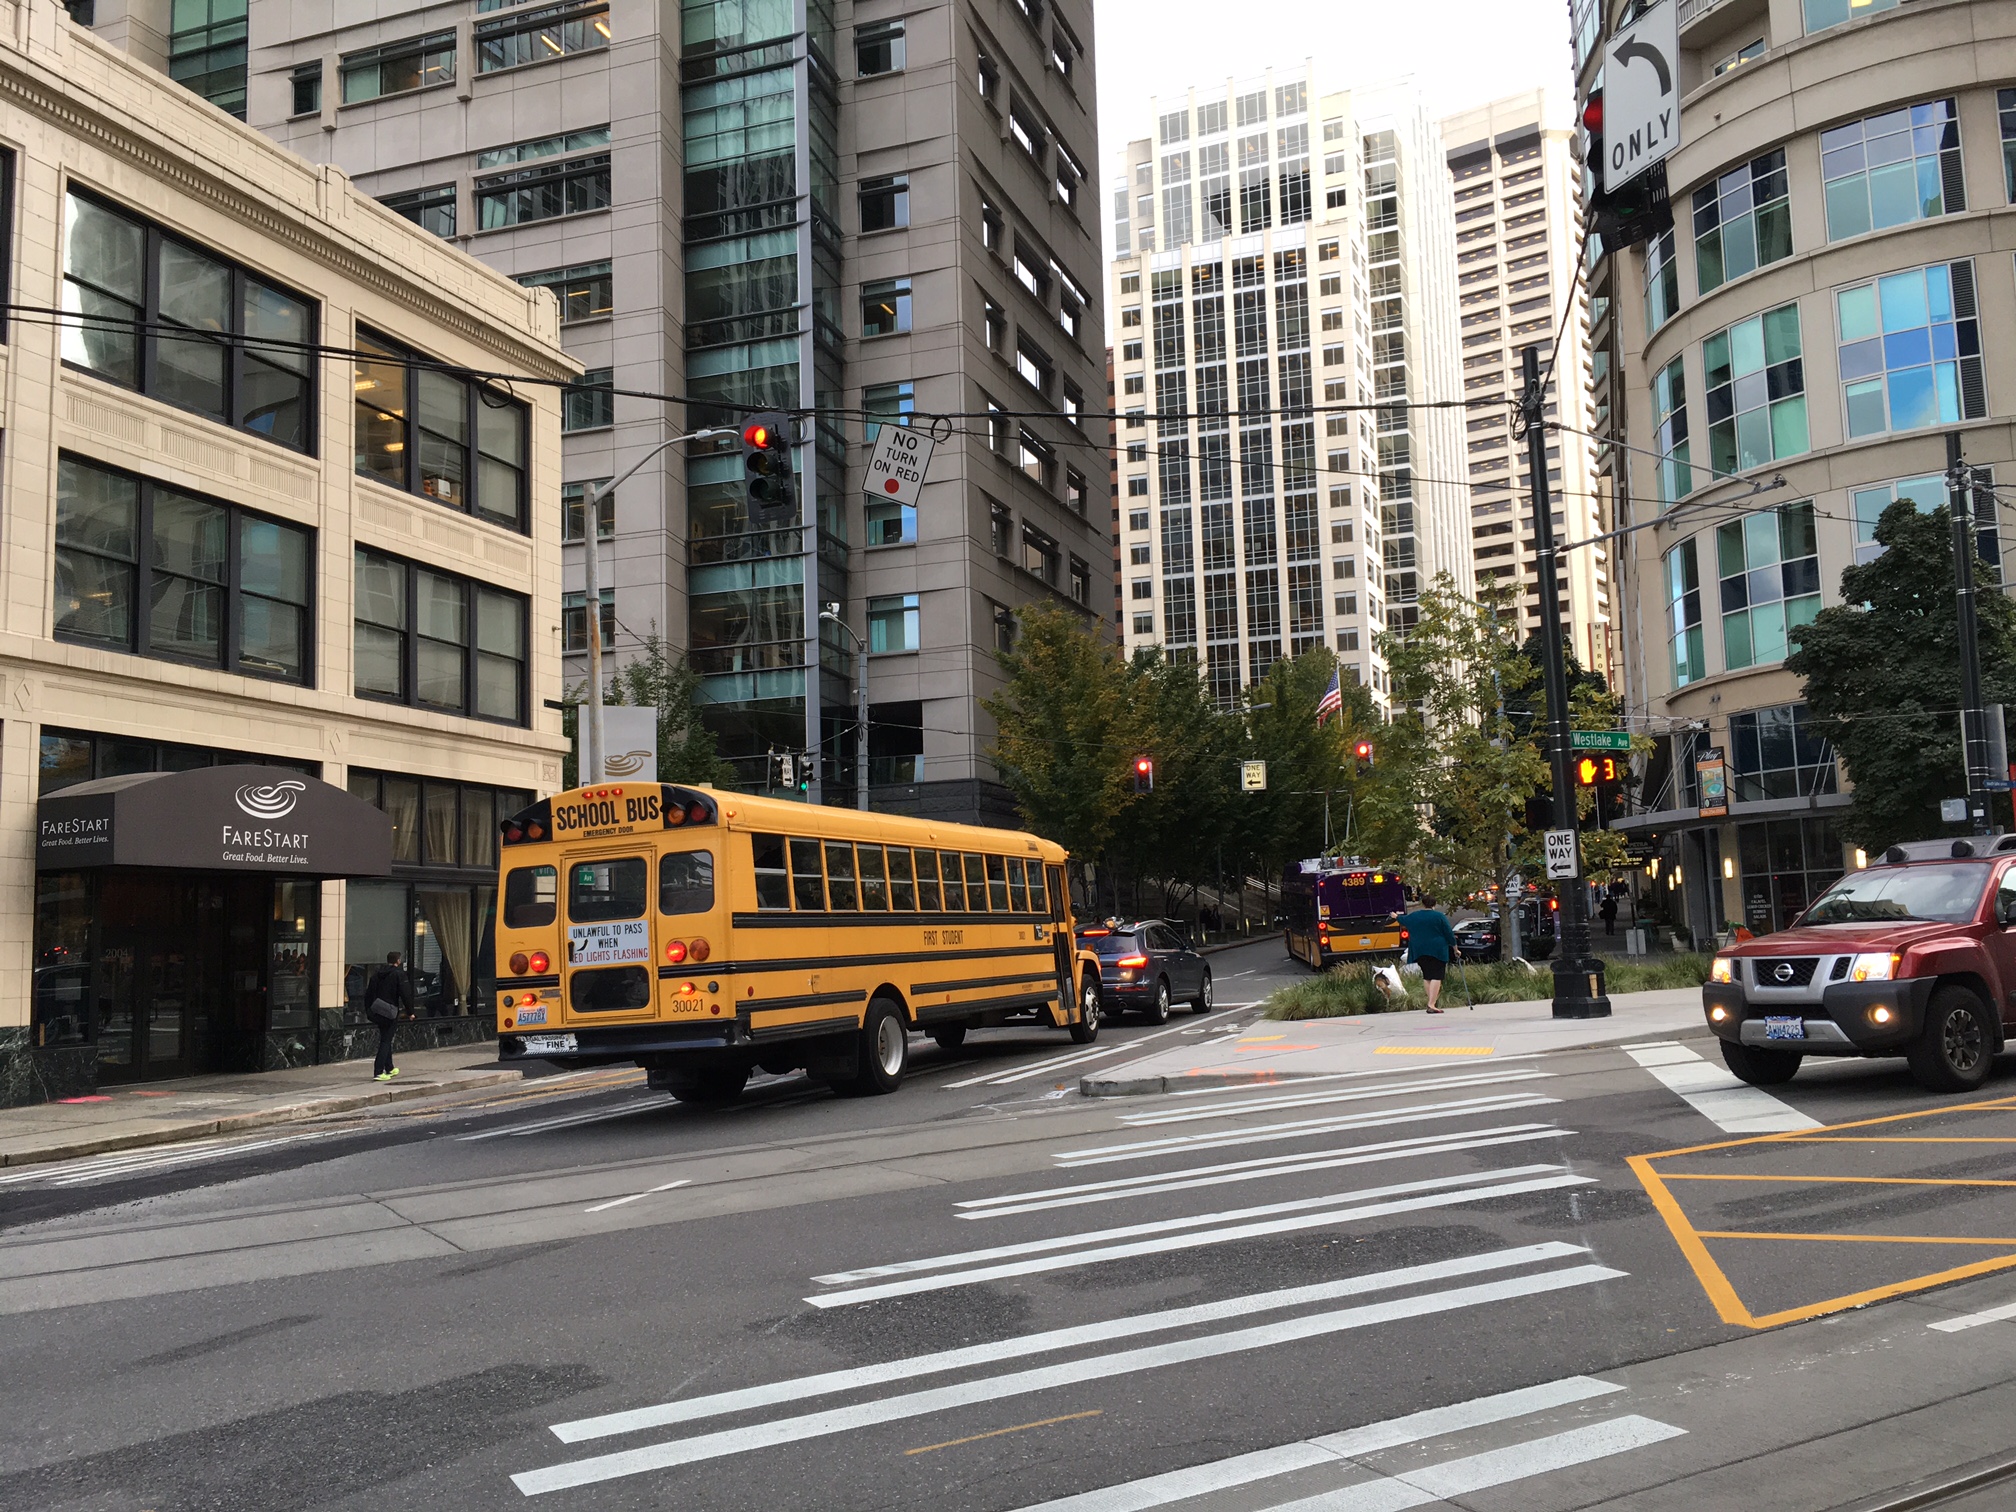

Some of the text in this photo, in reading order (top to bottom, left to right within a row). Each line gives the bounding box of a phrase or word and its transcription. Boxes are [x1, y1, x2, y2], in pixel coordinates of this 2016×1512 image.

[1612, 107, 1672, 171] ONLY
[893, 431, 918, 450] NO
[886, 447, 918, 467] TURN
[874, 459, 920, 483] ON RED
[1594, 624, 1604, 669] METRO
[1572, 732, 1628, 747] Westlake Ave
[1604, 758, 1614, 780] 3
[556, 795, 660, 831] SCHOOL BUS
[42, 818, 109, 835] FARESTART
[583, 825, 634, 838] EMERGENCY DOOR
[41, 835, 109, 847] Great Food. Better Lives.
[222, 825, 309, 849] FARESTART
[1548, 834, 1571, 846] ONE
[222, 851, 309, 864] Great Food. Better Lives.
[1548, 847, 1572, 860] WAY
[583, 874, 592, 882] Ave
[1341, 876, 1365, 887] 4389
[572, 922, 643, 939] UNLAWFUL TO PASS
[923, 929, 964, 946] FIRST STUDENT
[598, 937, 619, 949] WHEN
[105, 948, 128, 959] 2004
[586, 950, 611, 962] LIGHTS
[613, 947, 648, 960] FLASHING
[672, 998, 704, 1013] 30021
[546, 1041, 566, 1049] FINE
